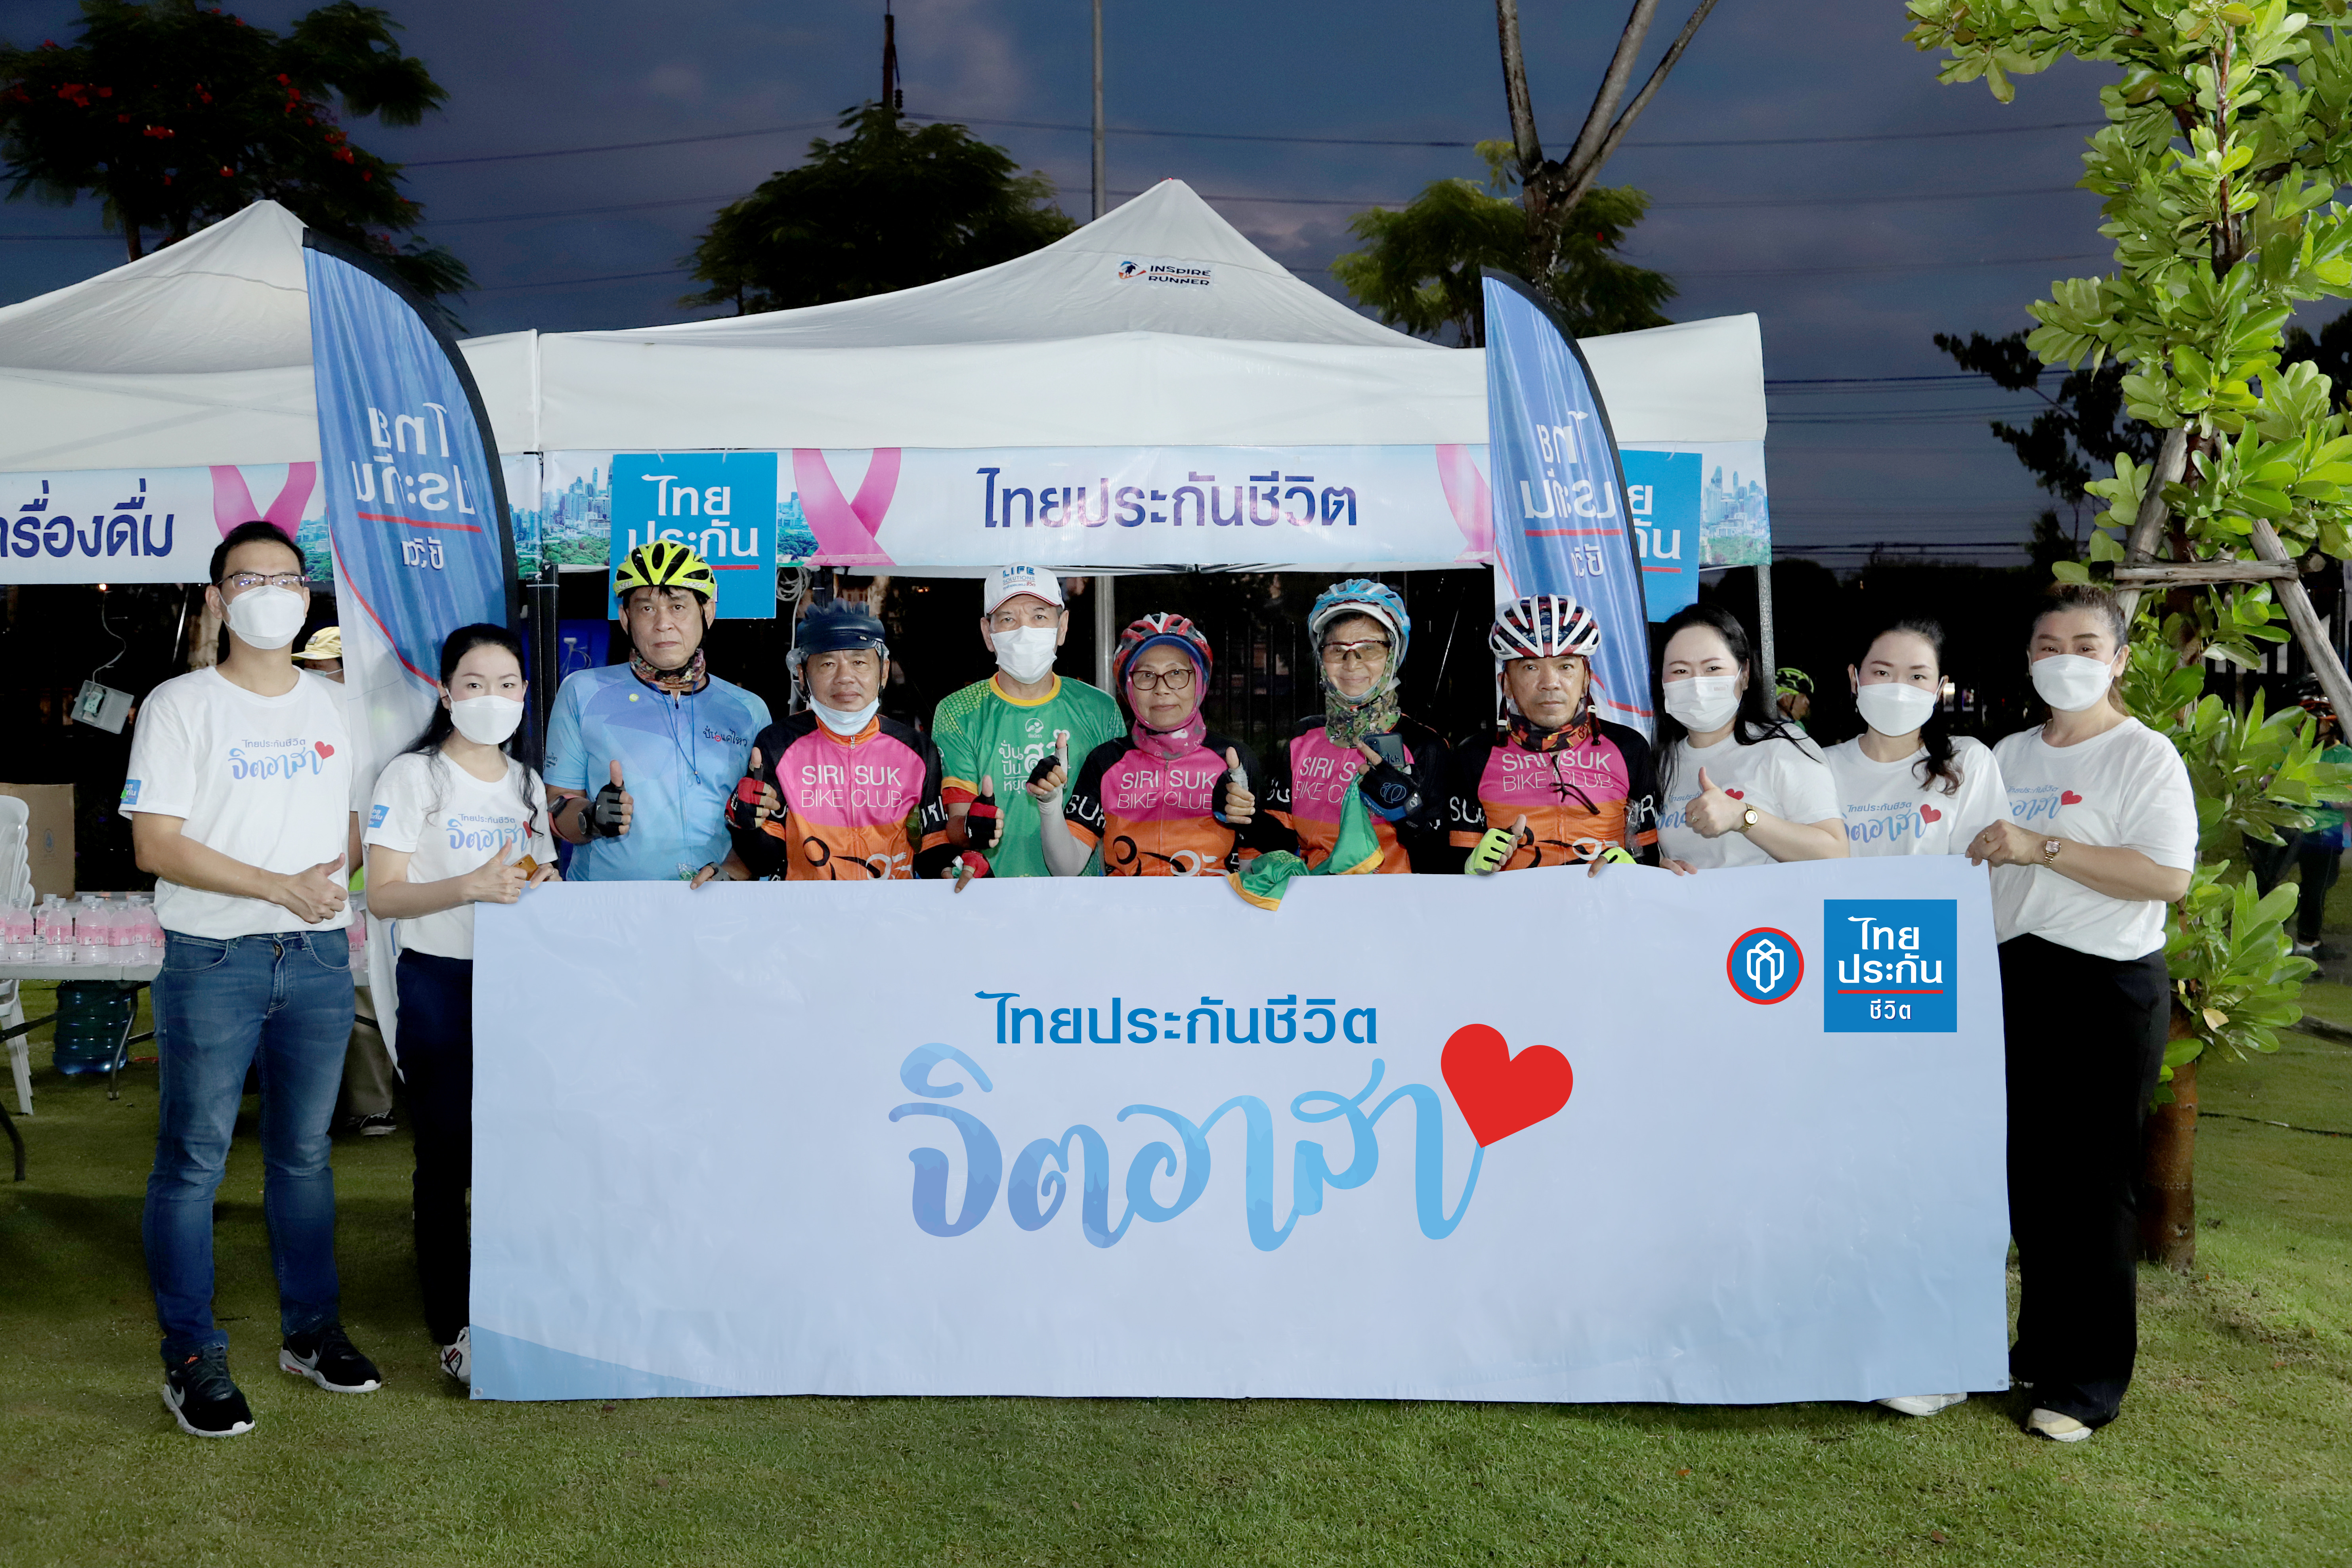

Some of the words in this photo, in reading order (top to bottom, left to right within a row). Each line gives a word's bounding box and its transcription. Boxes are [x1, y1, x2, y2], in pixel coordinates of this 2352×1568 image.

[1148, 276, 1210, 286] RUNNER
[1150, 265, 1211, 277] INSPIRE
[641, 474, 730, 516] ไทย
[976, 468, 1357, 527] ไทยประกันชีวิต
[0, 478, 174, 558] รื่องดื่ม
[1003, 566, 1035, 578] LIFE
[1003, 575, 1035, 584] SOLUTIONS
[681, 581, 708, 589] LAZER
[242, 738, 306, 748] ไทยประกันชีวิต
[228, 747, 324, 780] จิตอาสา
[1300, 756, 1335, 779] SIRI
[1502, 752, 1547, 772] SIRI
[1560, 749, 1611, 772] SUK
[802, 764, 844, 785] SIRI
[854, 765, 902, 787] SUK
[1120, 770, 1159, 790] SIRI
[1169, 769, 1217, 789] SUK
[1503, 771, 1546, 792] BIKE
[802, 789, 844, 808] BIKE
[851, 789, 902, 808] CLUB
[2007, 784, 2059, 794] ไทยประกันชีวิต
[1117, 792, 1158, 809] BIKE
[1847, 802, 1912, 813] ไทยประกันชีวิต
[458, 814, 515, 823] ไทยประกันชีวิต
[1848, 916, 1919, 950] ไทย
[1838, 953, 1943, 983] ประกัน
[974, 991, 1377, 1044] ไทยประกันชีวิต
[1870, 997, 1911, 1020] ชีวิต
[888, 1042, 1486, 1252] จิตอาสา
